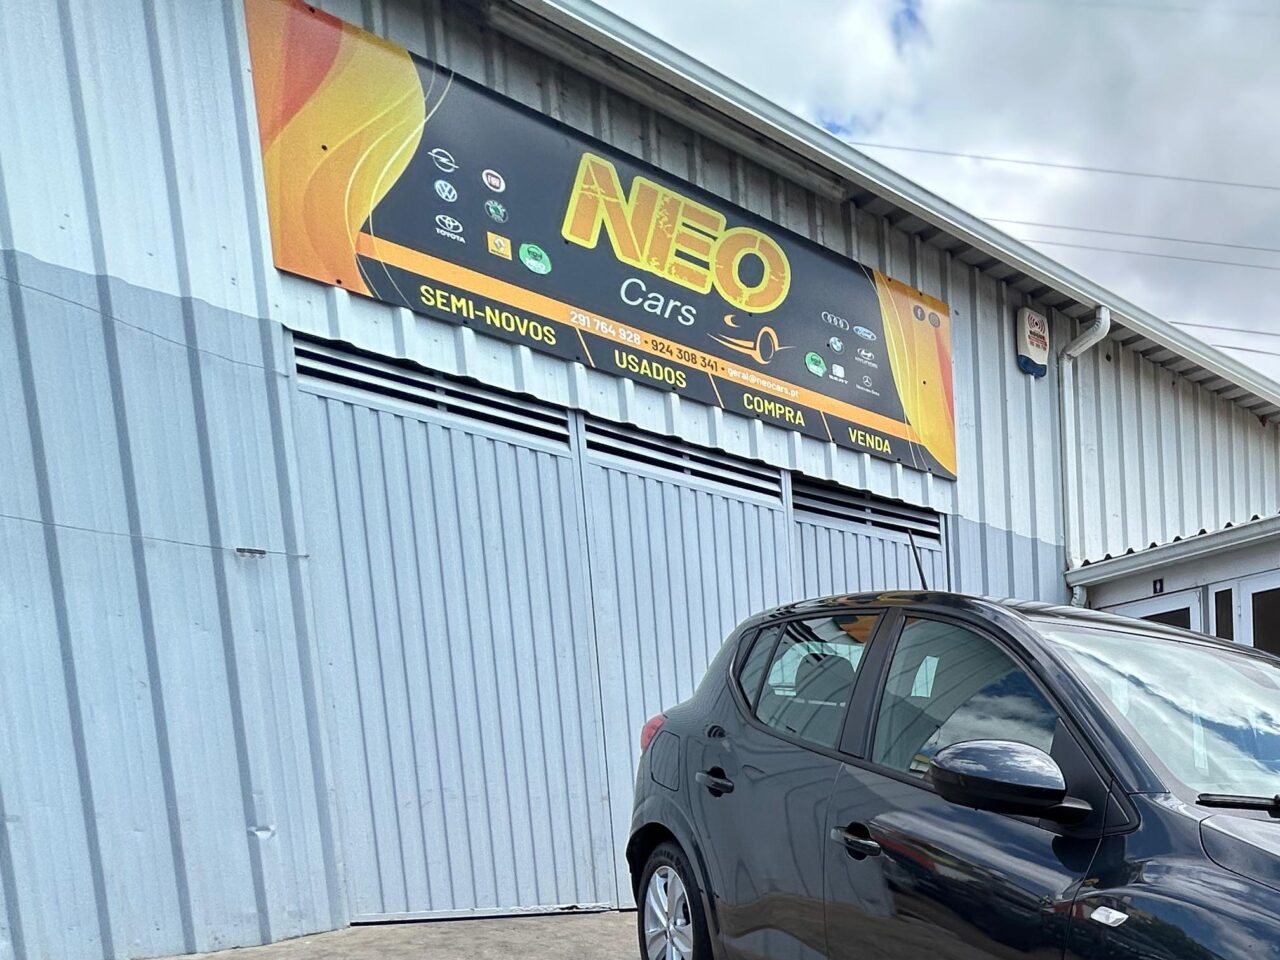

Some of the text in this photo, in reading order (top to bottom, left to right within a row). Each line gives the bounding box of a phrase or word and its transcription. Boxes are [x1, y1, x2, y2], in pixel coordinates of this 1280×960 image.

[435, 227, 466, 243] TOYOTA
[562, 152, 791, 313] NEO
[420, 285, 556, 345] SEMI-NOVOS
[620, 278, 697, 326] Cars
[569, 311, 591, 327] 291
[593, 318, 616, 337] 764
[619, 325, 641, 345] 928
[651, 339, 673, 356] 924
[676, 347, 698, 364] 308
[700, 355, 718, 372] 341
[727, 367, 800, 399] geral@neocars.pt
[614, 350, 687, 388] USADOS
[743, 392, 805, 427] COMPRA
[847, 427, 892, 454] VENDA
